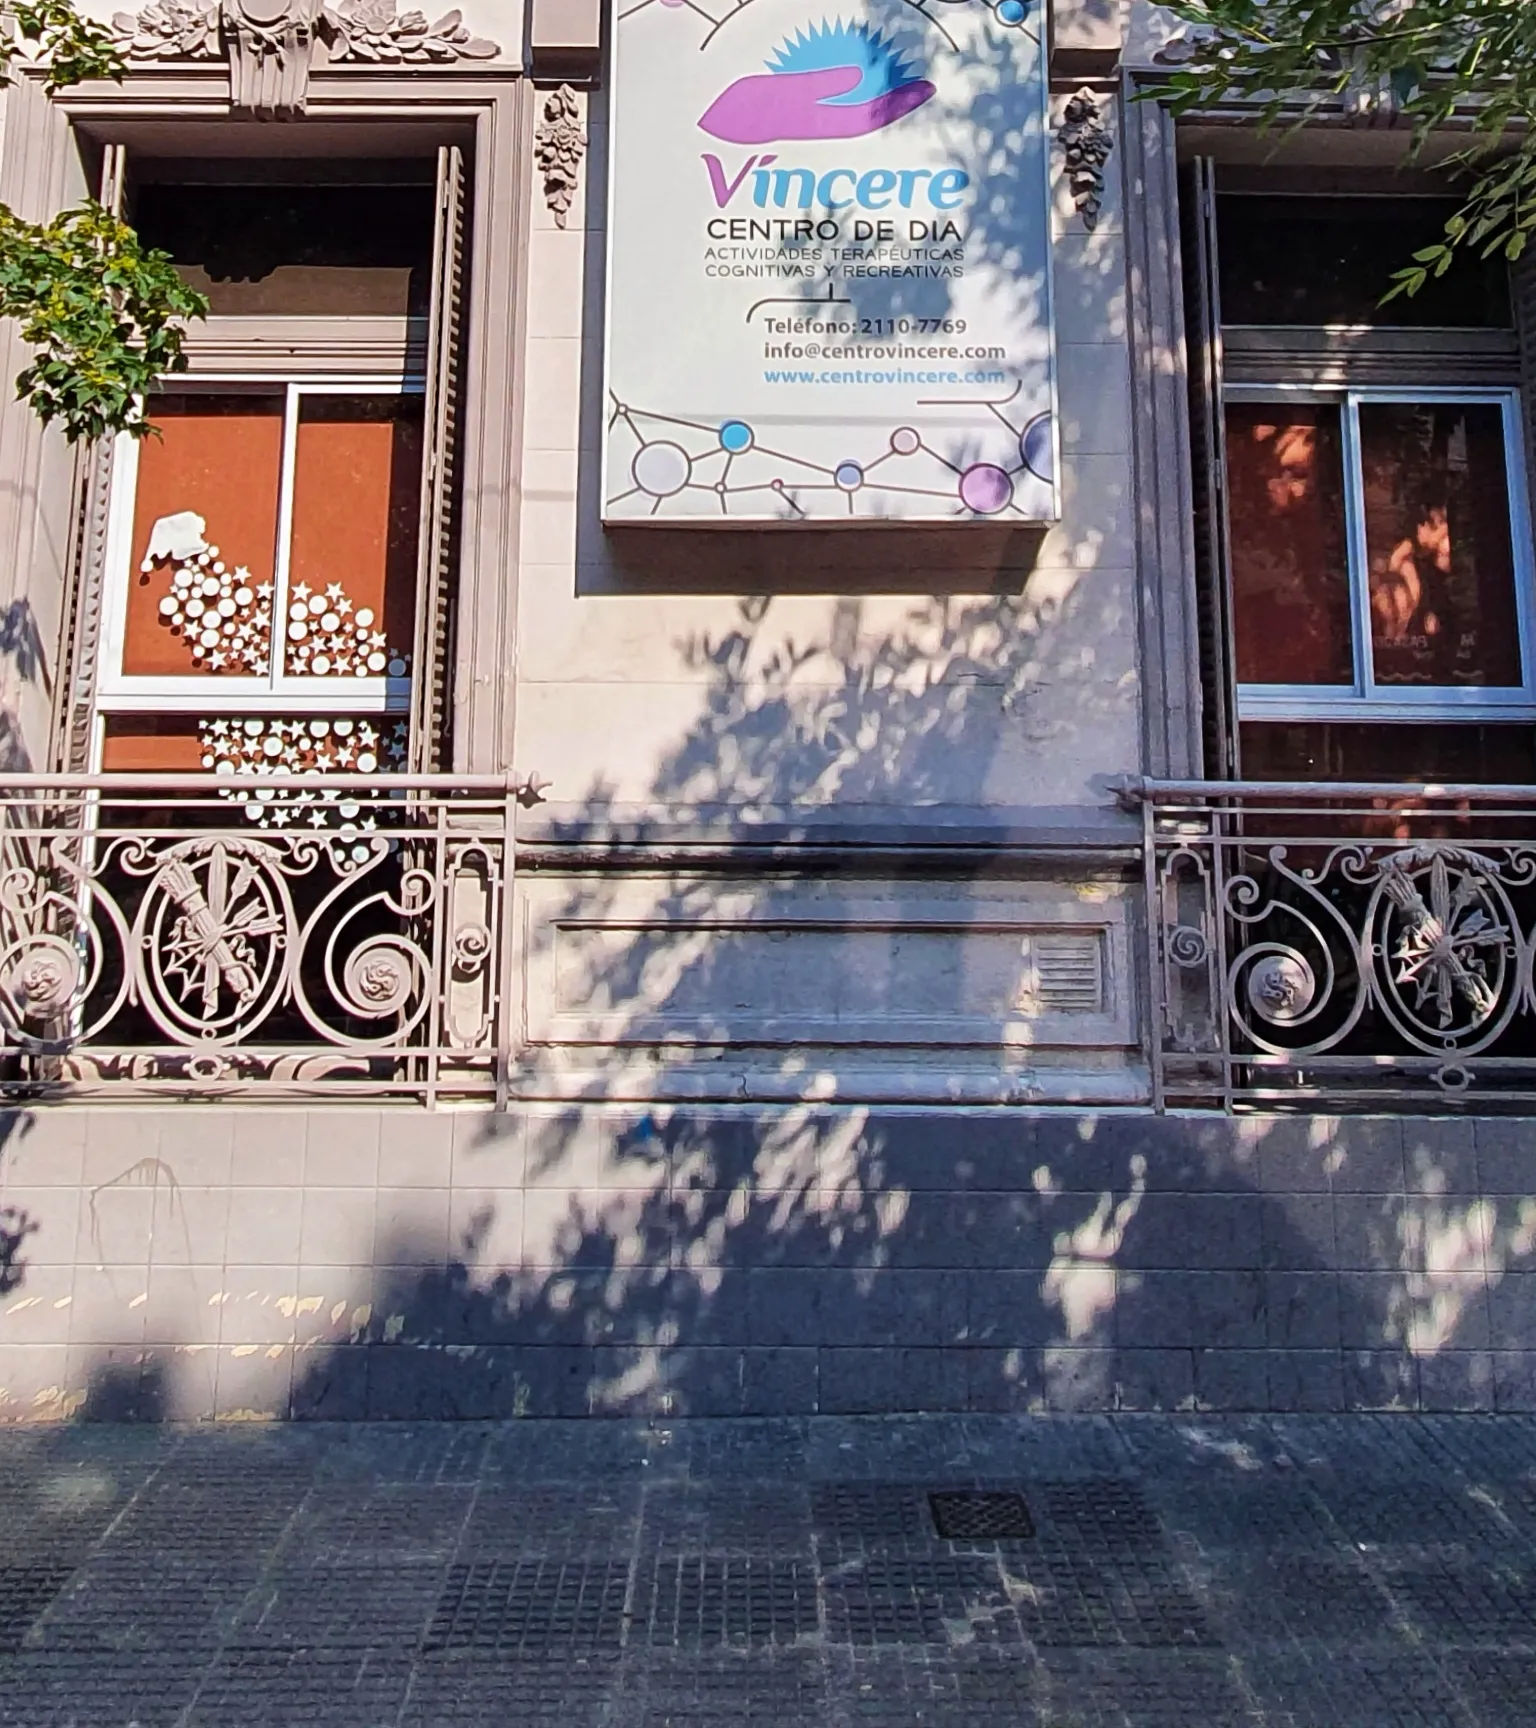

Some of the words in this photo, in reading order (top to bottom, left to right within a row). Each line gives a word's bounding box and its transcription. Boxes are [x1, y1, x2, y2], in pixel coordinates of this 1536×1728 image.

[707, 218, 840, 241] CENTRO
[854, 220, 895, 241] DE
[909, 220, 963, 242] DIA
[704, 247, 823, 261] ACTIVIDADES
[830, 244, 965, 261] TERAPÉUTICAS
[705, 264, 816, 278] COGNITIVAS
[824, 265, 836, 278] Y
[843, 265, 965, 279] RECREATIVAS
[862, 318, 968, 335] 2110-7769
[764, 342, 1007, 360] info@centrovincere.com
[764, 367, 1007, 384] www.centrovincere.com
